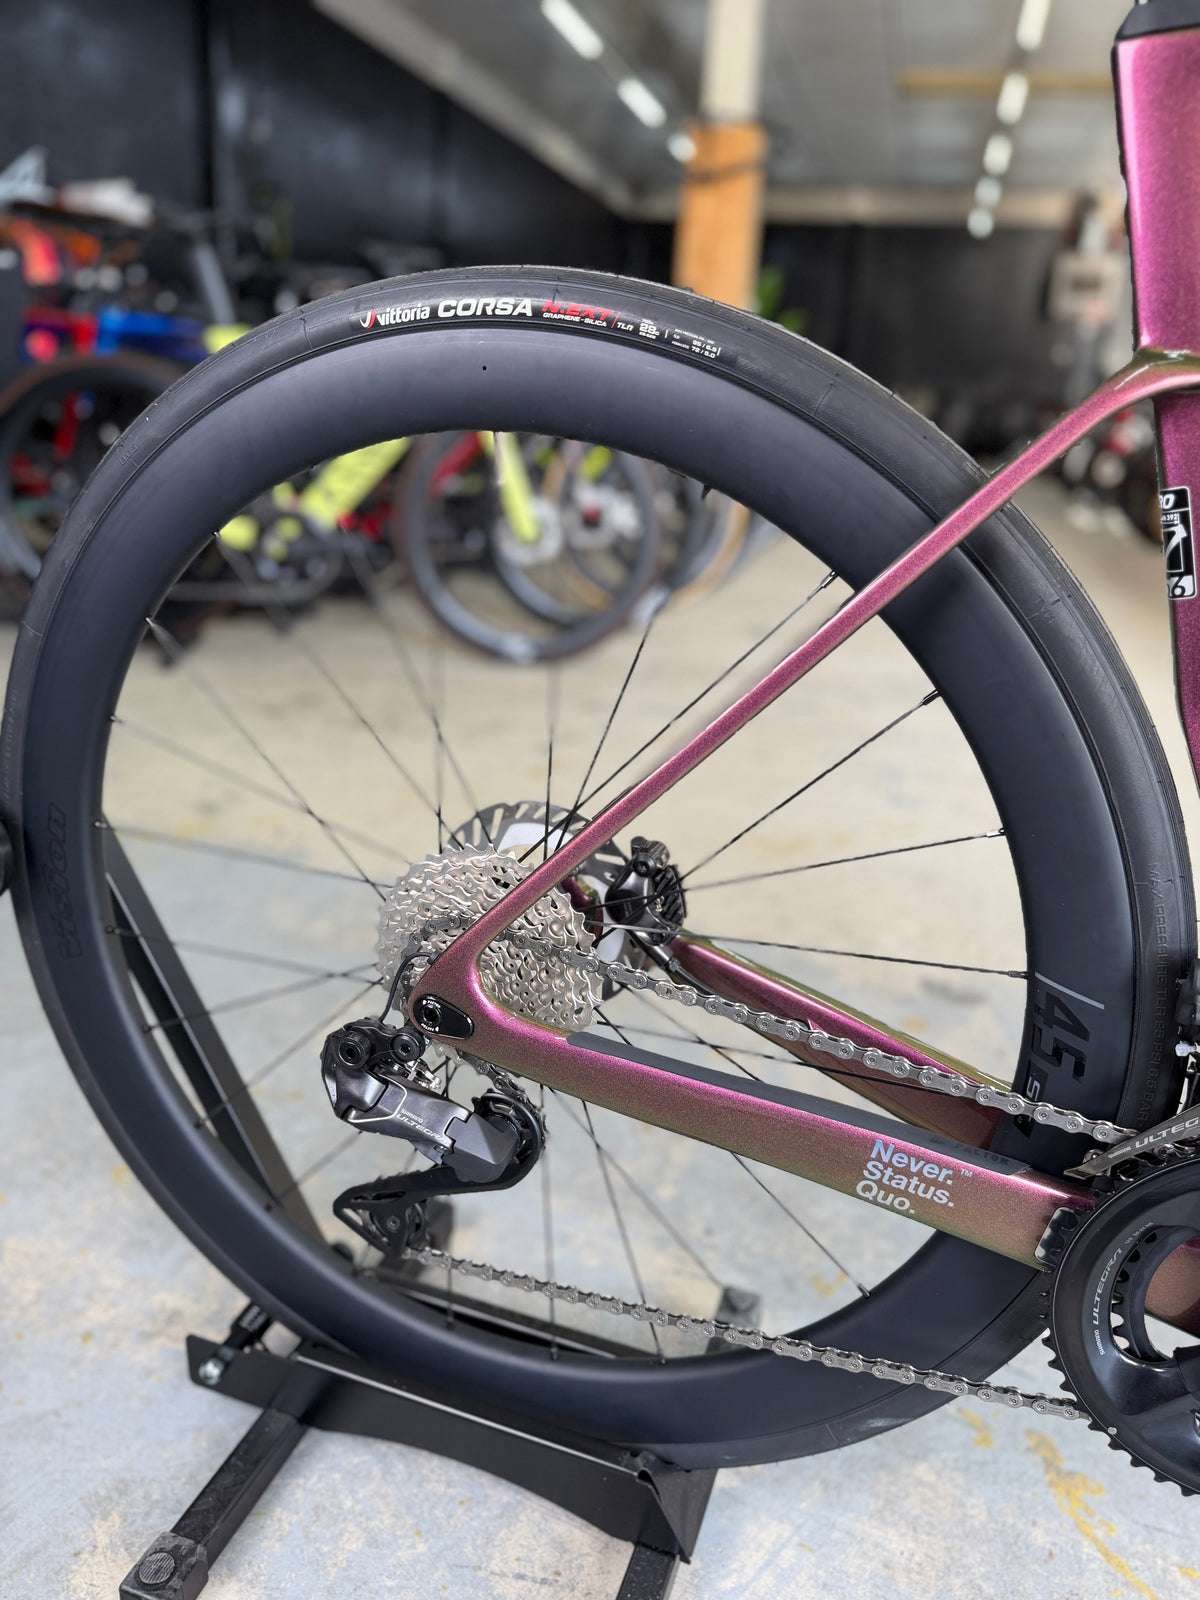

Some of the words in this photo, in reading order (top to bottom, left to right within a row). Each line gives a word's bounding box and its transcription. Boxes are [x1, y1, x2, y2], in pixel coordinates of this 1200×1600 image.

[376, 304, 430, 326] vittoria
[437, 298, 532, 318] CORSA
[541, 300, 615, 321] N.EXT
[1154, 904, 1169, 984] PRESSURE
[1031, 990, 1091, 1084] 45
[863, 1160, 955, 1207] Status.
[870, 1139, 953, 1185] Never.
[856, 1180, 916, 1214] Quo.
[1092, 1247, 1122, 1325] ULTEGRA
